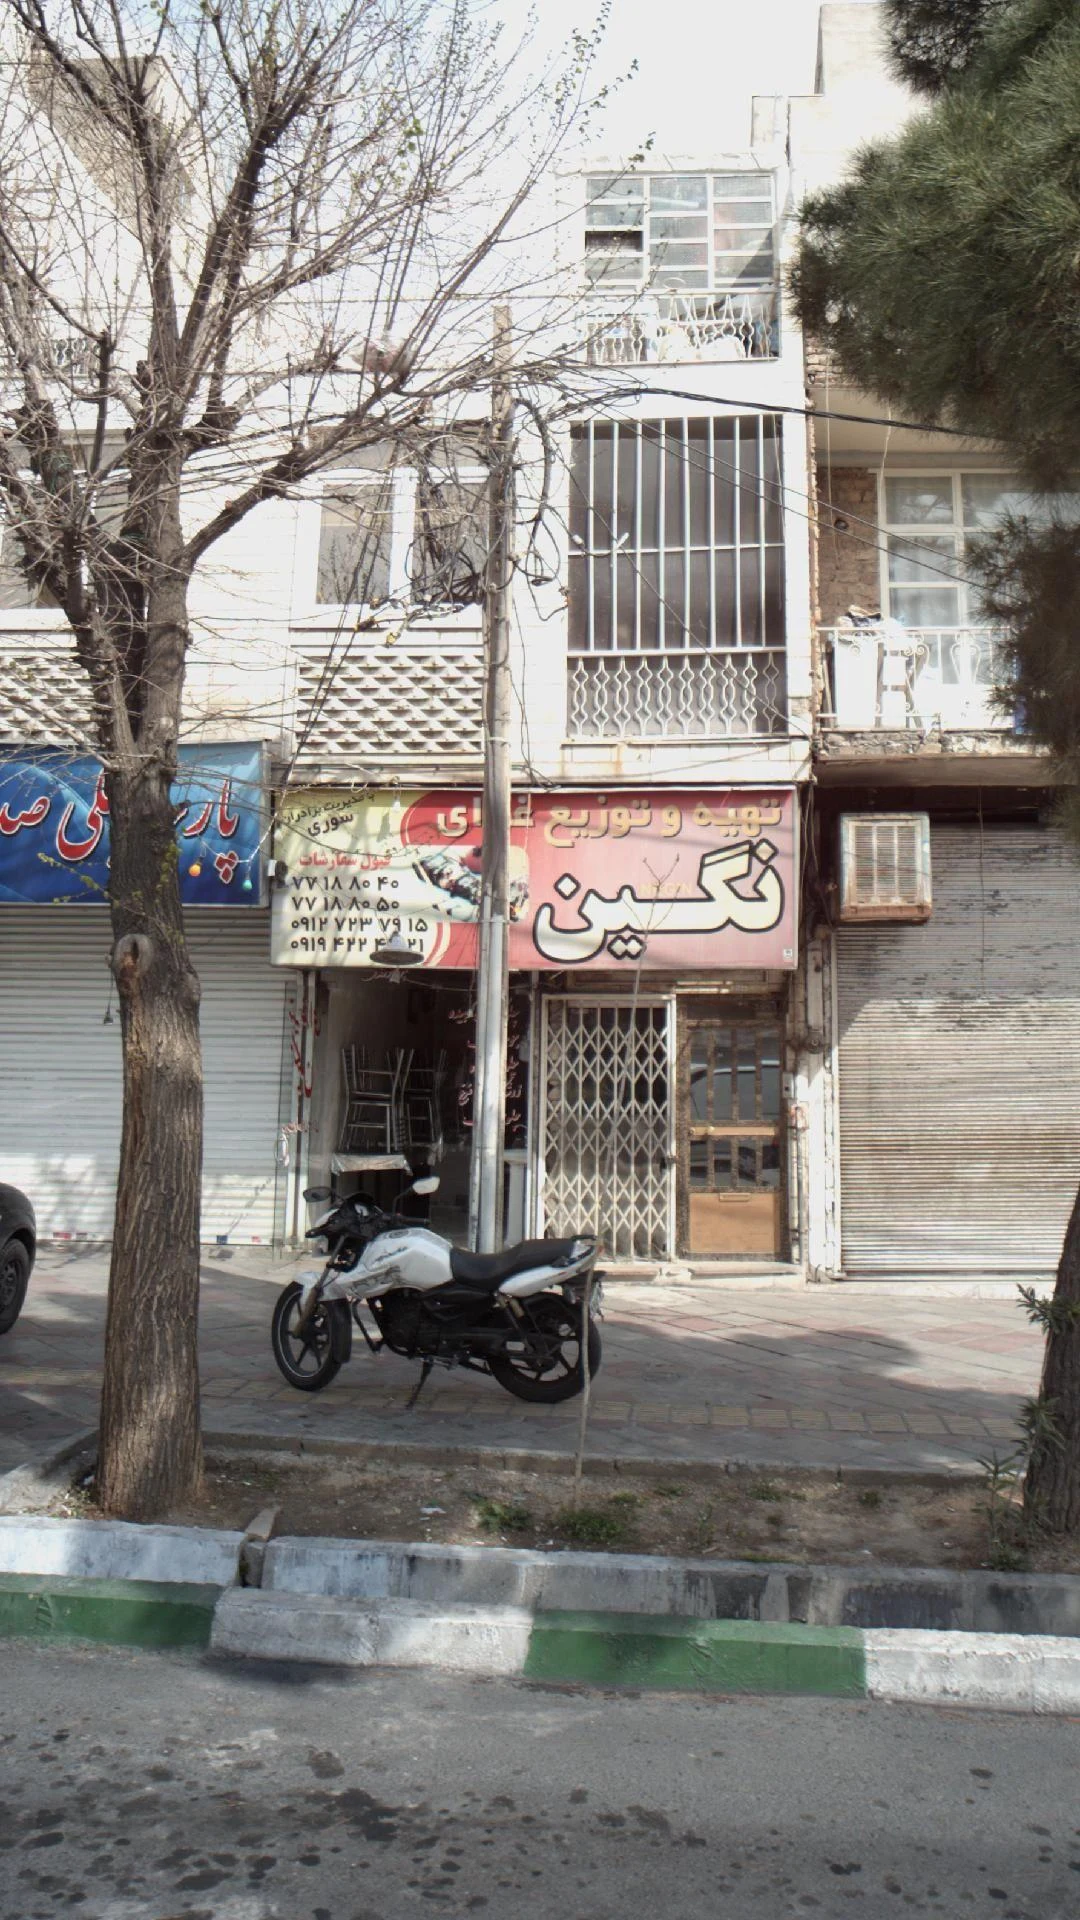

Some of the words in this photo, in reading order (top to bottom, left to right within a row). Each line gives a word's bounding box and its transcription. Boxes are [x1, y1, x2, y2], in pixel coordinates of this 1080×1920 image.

[306, 812, 355, 837] سوری
[543, 794, 653, 848] توزیع
[660, 803, 683, 838] و
[692, 797, 783, 838] تهیه
[291, 875, 318, 891] ۷۷
[323, 876, 343, 891] ۱۸
[348, 876, 371, 891] ۸۰
[377, 876, 400, 891] ۴۰
[290, 896, 318, 911] ۷۷
[323, 896, 342, 911] ۱۸
[348, 896, 371, 911] ۸۰
[376, 896, 400, 912] ۵۰
[532, 838, 786, 964] نگین
[291, 916, 328, 932] ۰۹۱۲
[334, 917, 373, 932] ۷۲۳
[379, 917, 402, 932] ۷۹
[408, 917, 429, 932] ۱۵
[290, 936, 327, 952] ۰۹۱۹
